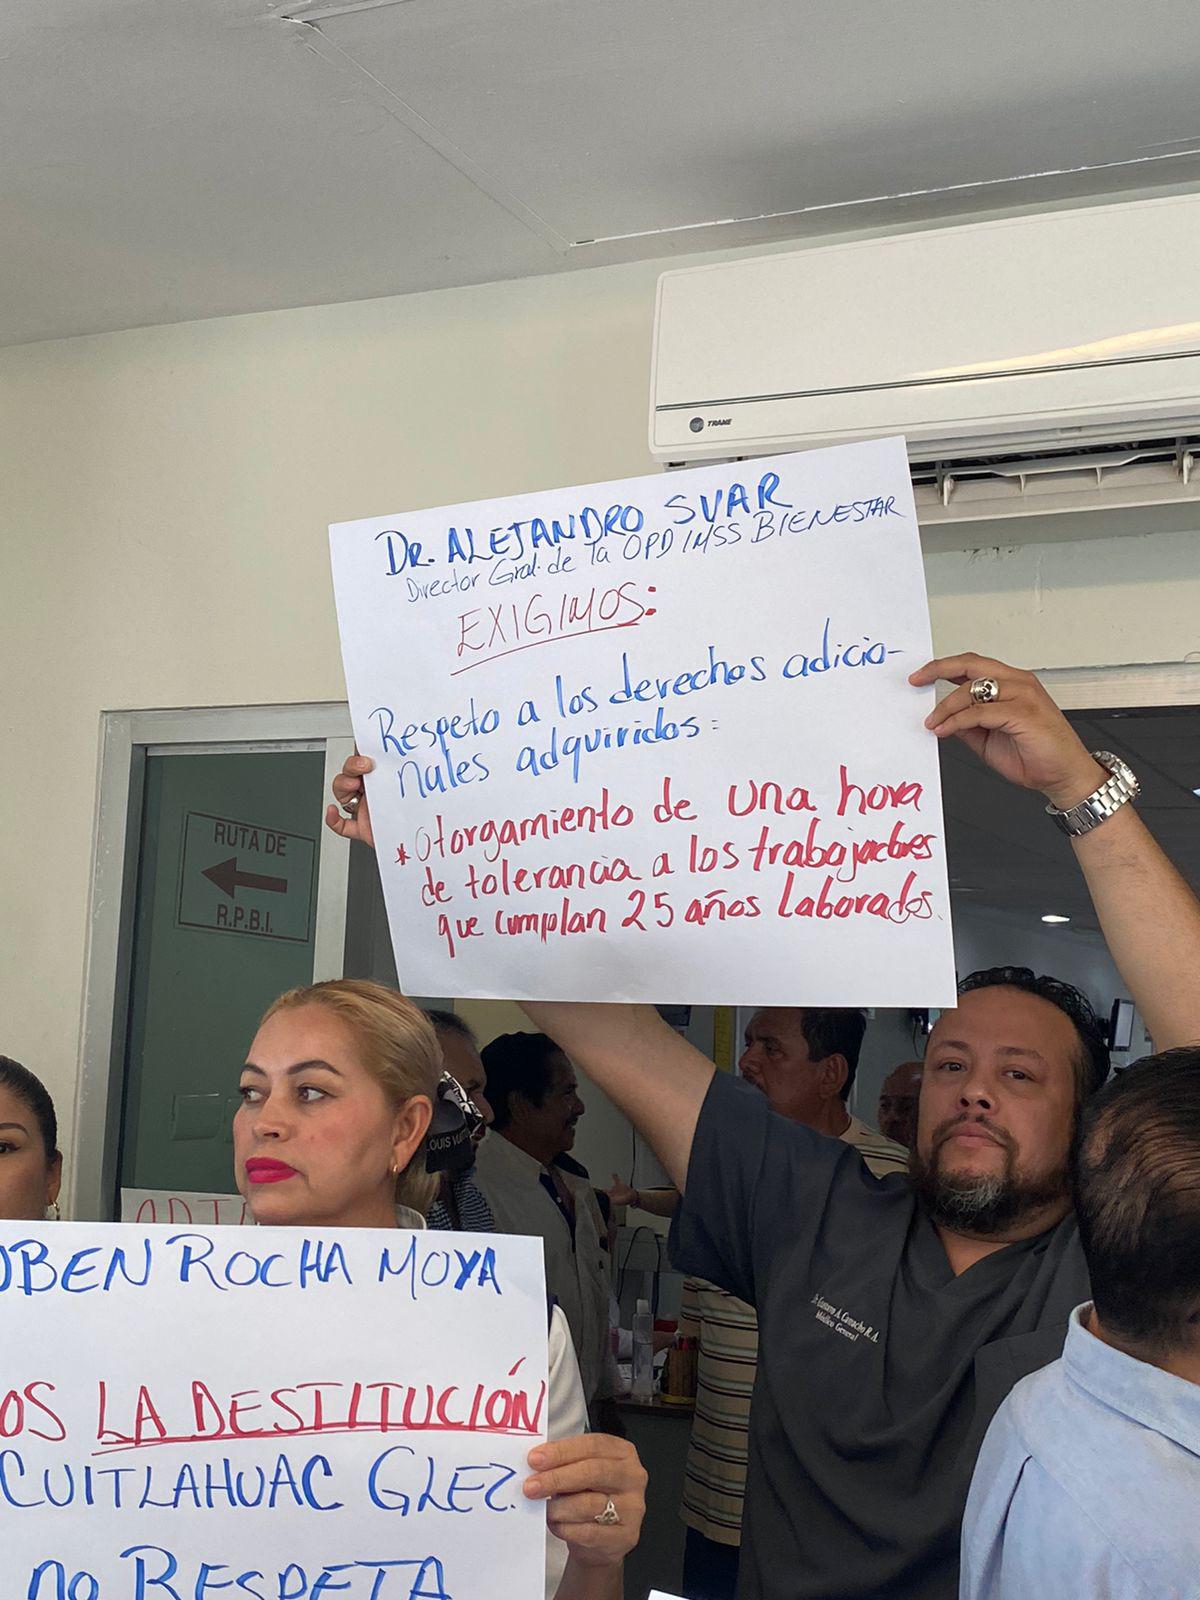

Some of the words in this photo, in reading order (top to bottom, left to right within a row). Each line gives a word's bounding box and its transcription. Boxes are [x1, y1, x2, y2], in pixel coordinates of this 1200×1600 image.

[707, 418, 732, 427] TRANE
[407, 569, 481, 602] Director
[548, 546, 576, 574] de
[623, 528, 674, 560] OPD
[682, 522, 742, 553] IMSS
[751, 495, 908, 544] BIENESTAR
[448, 504, 644, 563] ALEJANDRO
[456, 581, 657, 658] EXIGIMOS:
[368, 698, 500, 758] Respeto
[517, 700, 540, 726] a
[556, 675, 599, 718] los
[609, 651, 766, 704] derechos
[782, 618, 904, 679] adicio-
[214, 822, 260, 852] RUTA
[264, 833, 288, 857] DE
[415, 787, 634, 863] Otorgamiento
[654, 777, 698, 823] de
[837, 766, 924, 816] hora
[422, 866, 452, 907] de
[465, 856, 642, 899] tolerancia
[653, 853, 675, 877] a
[689, 835, 740, 873] los
[216, 903, 273, 933] R.P.B.I.
[438, 911, 484, 959] que
[495, 897, 607, 945] cumplan
[621, 889, 674, 931] 25
[685, 888, 762, 926] años
[165, 1233, 353, 1291] ROCHA
[379, 1234, 502, 1300] MOYA
[835, 1323, 859, 1341] General
[841, 1312, 866, 1333] Camacho
[97, 1381, 168, 1446] LA
[191, 1358, 546, 1438] DESTITUCIÓN
[0, 1449, 345, 1511] CUITLAHUAC
[119, 1545, 453, 1600] RESPETA
